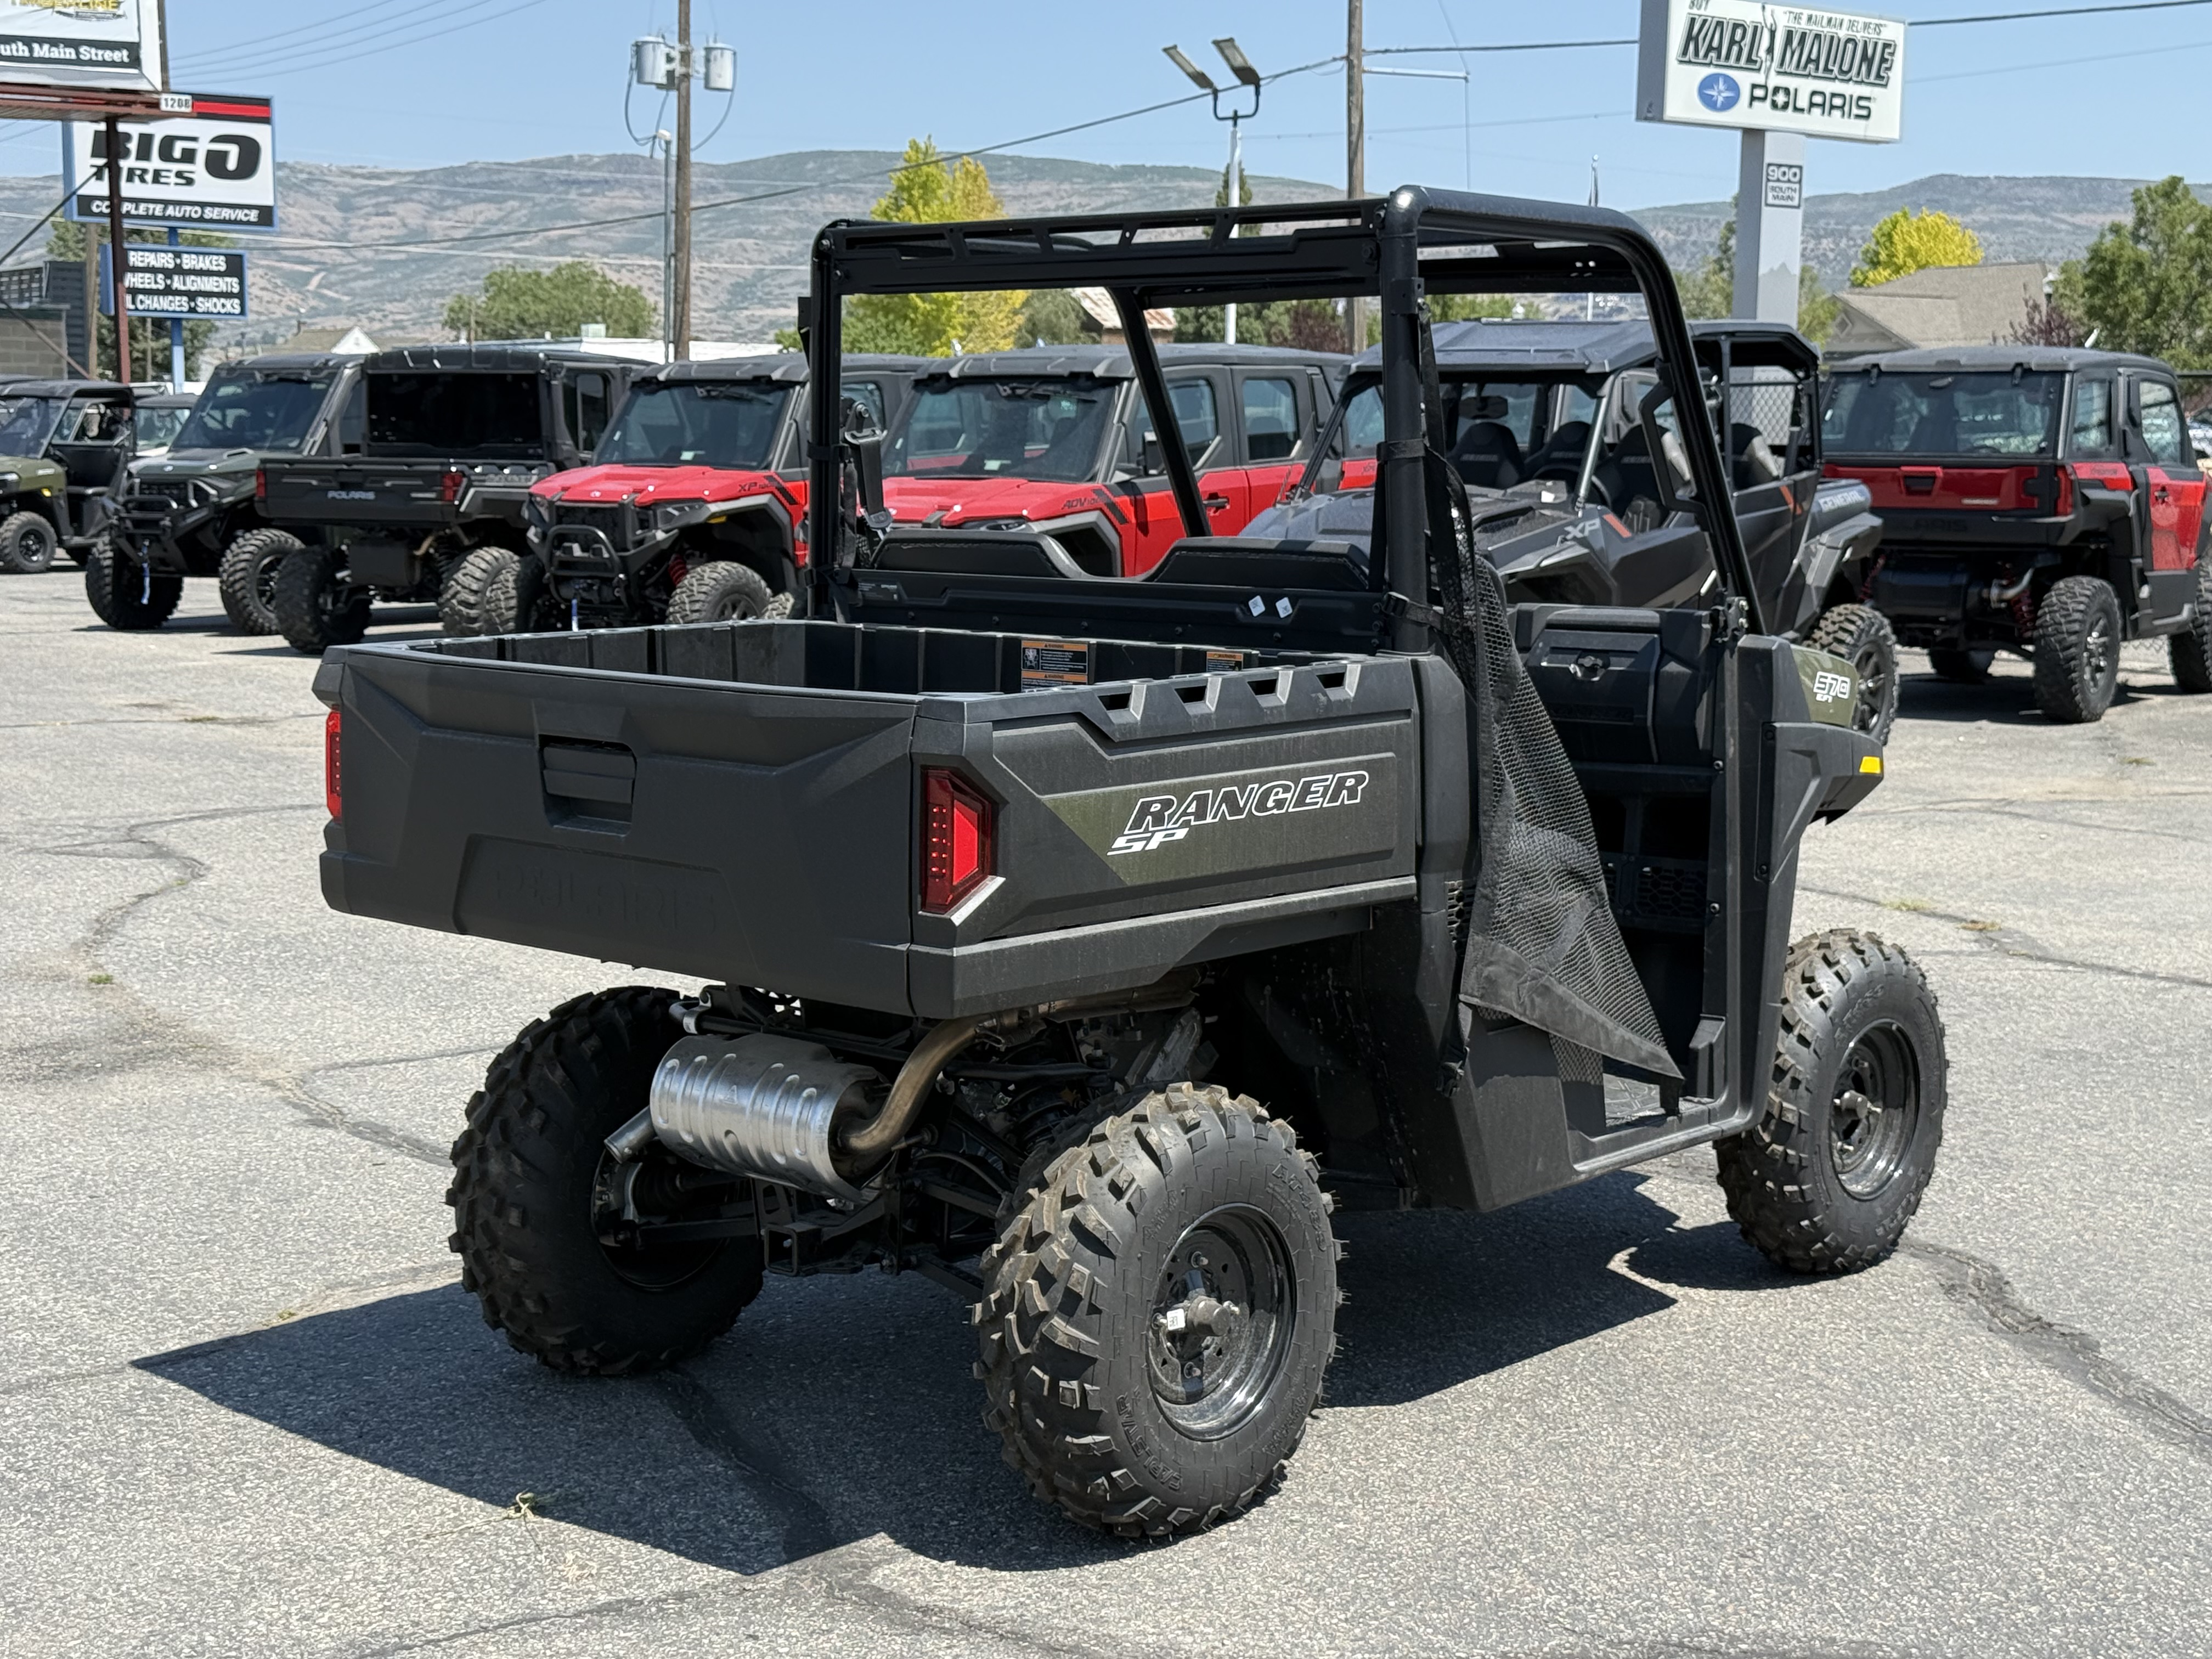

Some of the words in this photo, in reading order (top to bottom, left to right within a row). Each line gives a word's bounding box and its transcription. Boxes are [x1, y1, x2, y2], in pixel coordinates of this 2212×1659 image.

[1805, 13, 1844, 31] MAILMAN
[32, 42, 77, 60] Main
[78, 45, 129, 63] Street
[1677, 13, 1763, 72] KARL
[1775, 26, 1897, 88] MALONE
[1748, 83, 1872, 120] POLARIS
[91, 130, 199, 164] BIG
[205, 134, 261, 180] O
[89, 165, 196, 187] TRES
[1768, 166, 1800, 182] 900
[90, 200, 165, 217] COPLETE
[165, 206, 202, 219] AUTO
[203, 208, 259, 223] SERVICE
[128, 251, 175, 269] REPAIRS
[182, 253, 227, 272] BRAKES
[171, 274, 240, 294] ALIGNMENTS
[137, 294, 189, 312] CHANGES
[195, 296, 241, 314] SHOCKS
[327, 490, 376, 500] POLARIS
[738, 482, 758, 493] XP
[1564, 518, 1601, 541] XP
[1813, 671, 1851, 699] 570
[1124, 770, 1370, 835] RANGER
[1106, 827, 1190, 856] SP
